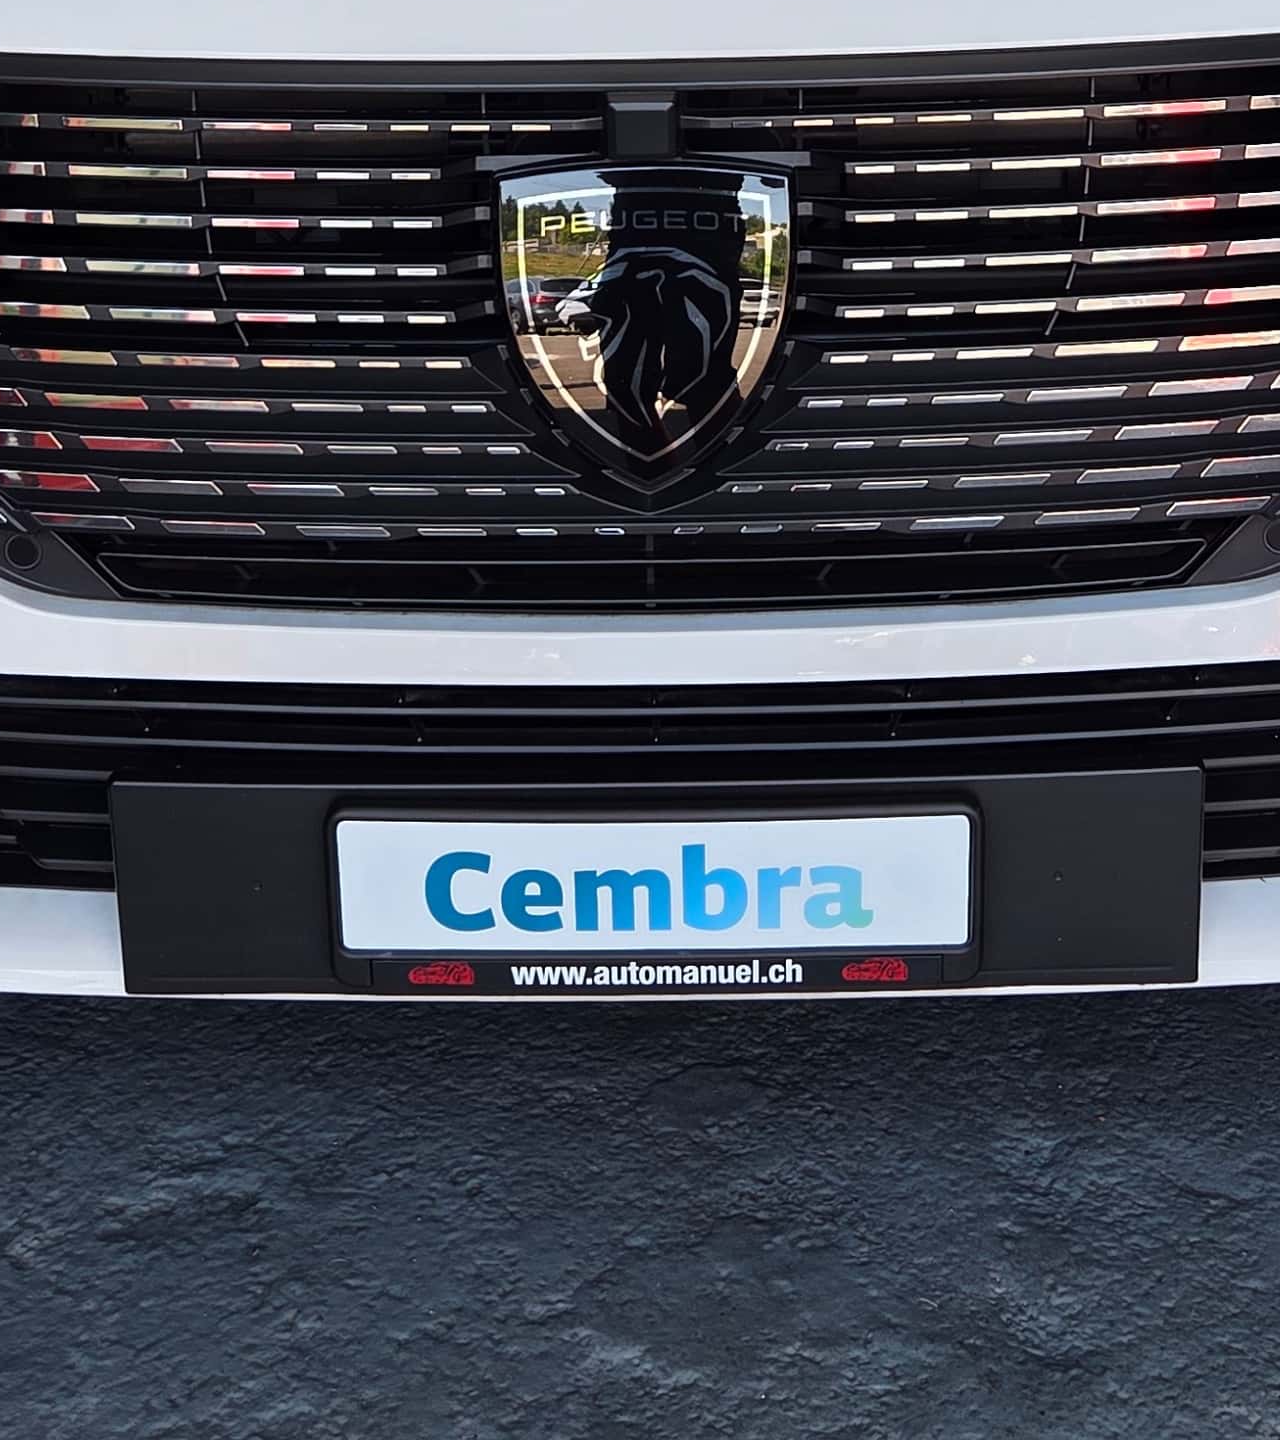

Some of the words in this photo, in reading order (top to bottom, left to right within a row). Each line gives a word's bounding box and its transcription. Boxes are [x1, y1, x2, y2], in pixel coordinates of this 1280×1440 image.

[539, 209, 750, 238] PEUGEOT
[423, 841, 874, 934] Cembra
[510, 958, 805, 988] www.automanuel.ch
